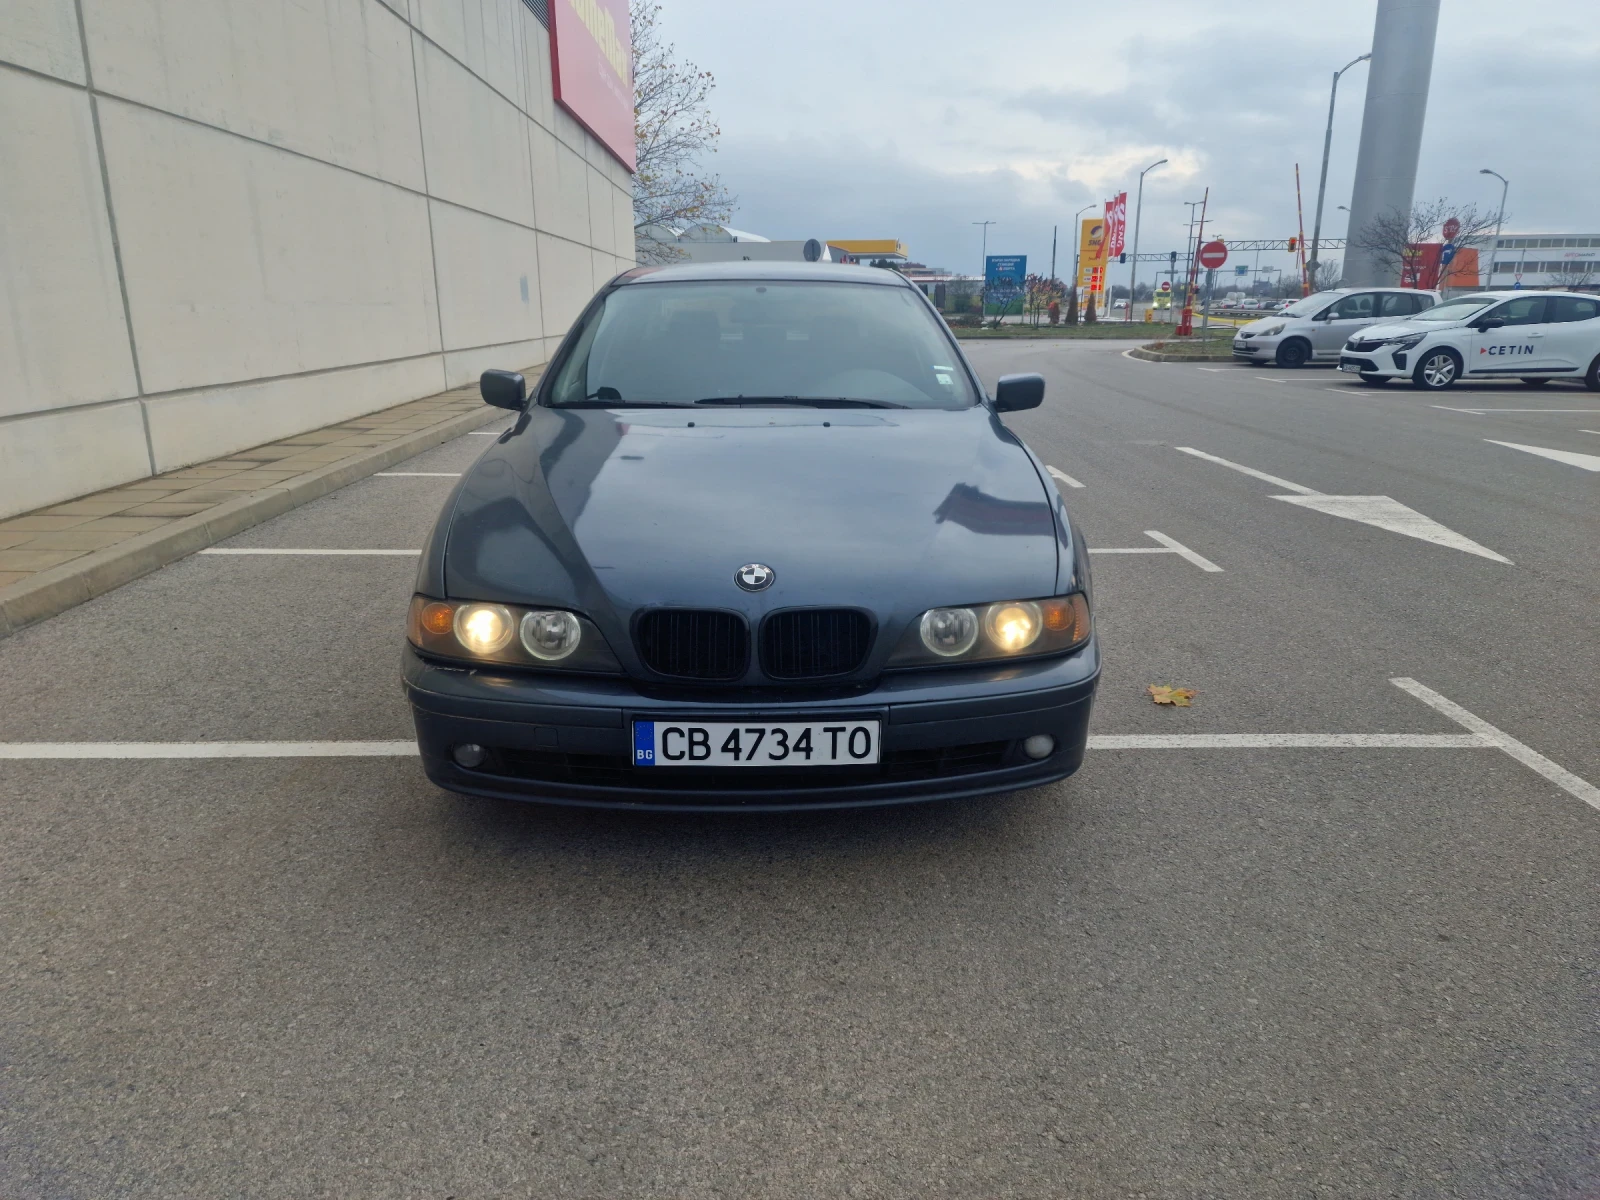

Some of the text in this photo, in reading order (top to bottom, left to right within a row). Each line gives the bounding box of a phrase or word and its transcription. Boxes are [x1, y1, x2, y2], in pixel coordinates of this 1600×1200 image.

[1488, 345, 1534, 356] CETIN
[662, 727, 871, 760] CB 4734 TO
[637, 750, 653, 760] BG
